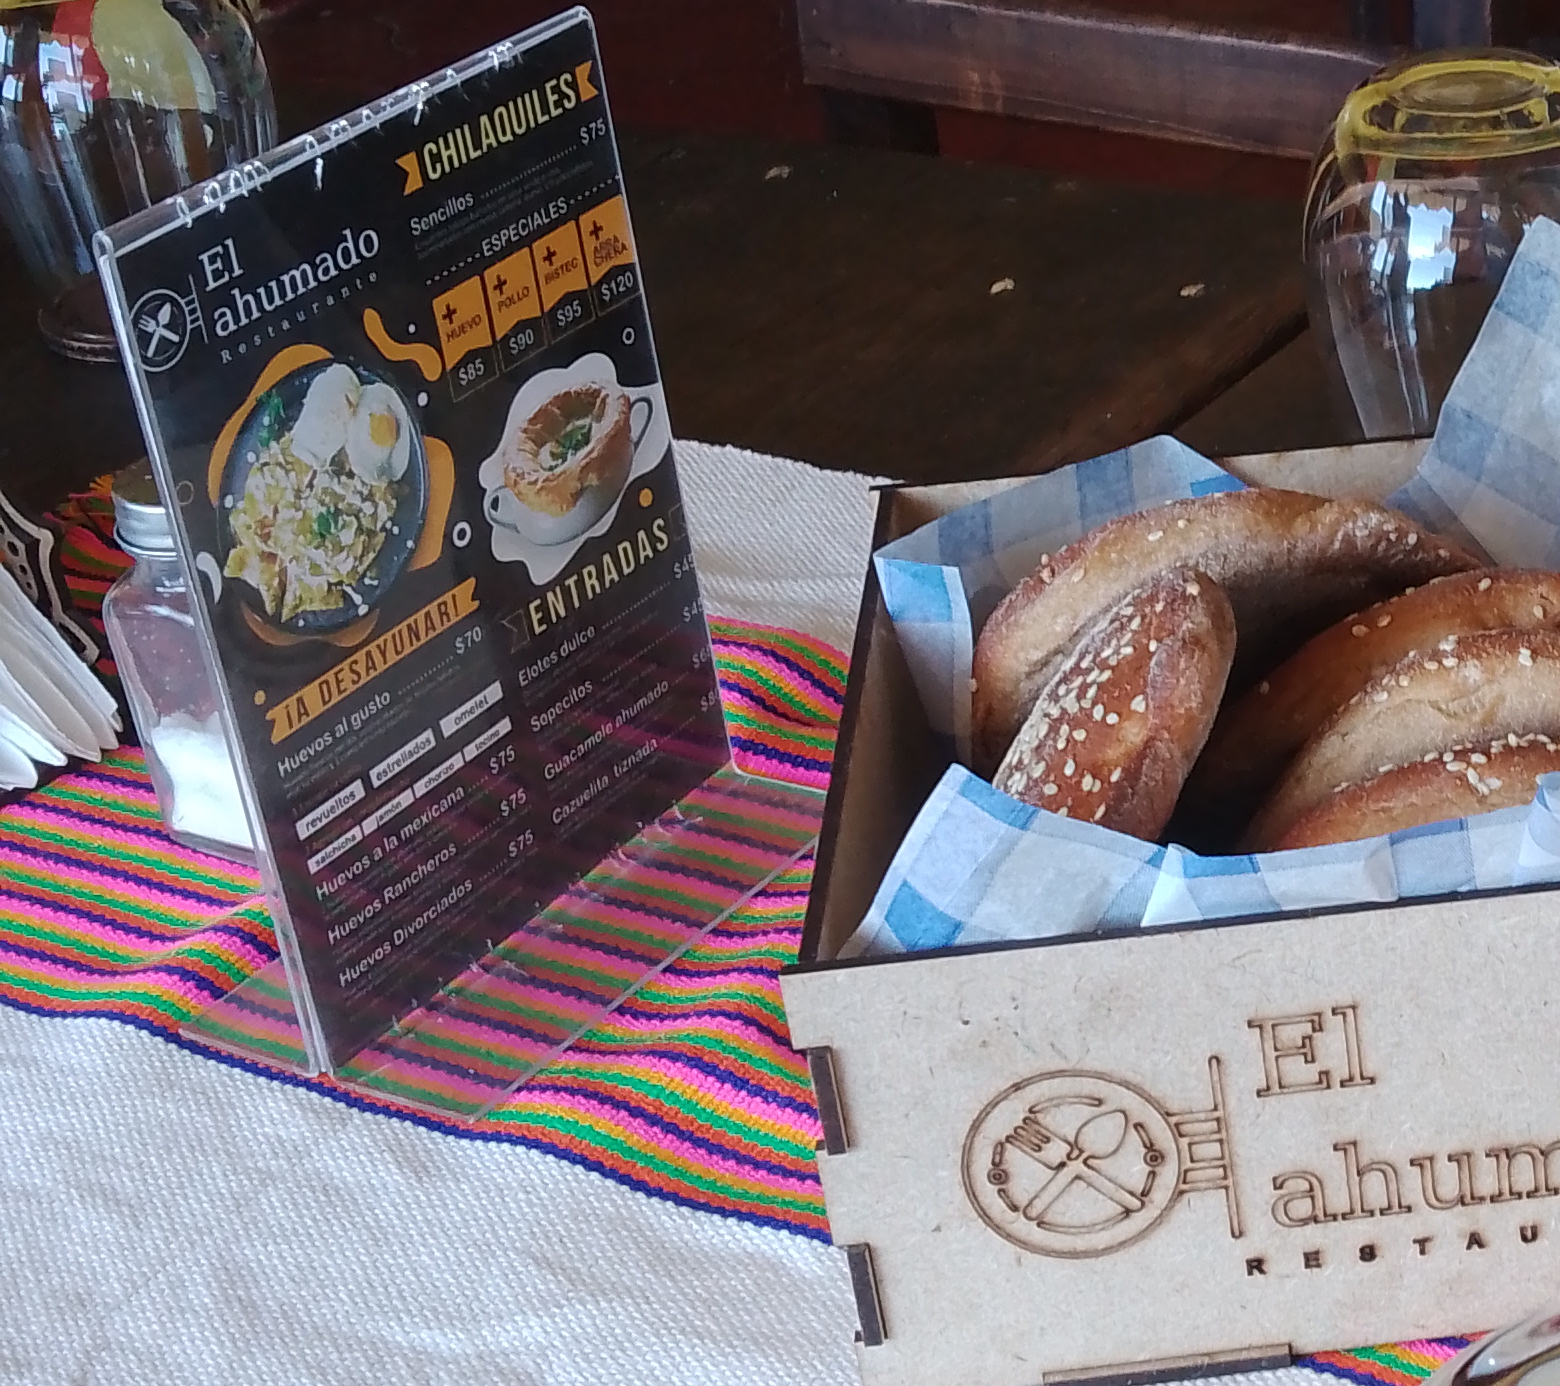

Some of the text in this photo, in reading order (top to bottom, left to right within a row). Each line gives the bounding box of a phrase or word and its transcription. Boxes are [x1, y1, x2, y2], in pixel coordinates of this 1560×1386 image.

[420, 70, 578, 182] CHILAQUILES
[409, 117, 607, 237] Sencillos $75
[198, 237, 244, 293] El
[480, 195, 568, 258] ESPECIALES
[212, 225, 380, 338] ahumado
[220, 271, 378, 363] Restaurante
[444, 312, 483, 343] HUEVO
[496, 284, 530, 313] POLLO
[555, 299, 582, 328] $95
[600, 269, 634, 303] $120
[456, 357, 485, 388] $85
[508, 327, 535, 357] $90
[527, 513, 670, 638] ENTRADAS
[517, 646, 559, 687] Elotes
[558, 619, 596, 659] dulce
[276, 623, 483, 779] Huevos al gusto $70
[529, 675, 593, 736] Sopecitos
[542, 718, 613, 782] Guacamole
[612, 676, 669, 729] ahumado
[303, 785, 356, 833] revueltos
[374, 731, 431, 781] estrellados
[452, 691, 489, 727] omelet
[550, 770, 610, 826] Cazuelita
[612, 733, 658, 780] tiznada
[313, 831, 356, 868] salchicha
[314, 849, 371, 903] Huevos
[371, 844, 383, 863] a
[382, 829, 399, 854] la
[398, 782, 465, 842] mexicana
[488, 743, 516, 776] $75
[326, 893, 382, 946] Huevos
[382, 839, 457, 905] Rancheros
[498, 785, 527, 819] $75
[337, 826, 534, 989] Huevos Divorciados $75
[1248, 1004, 1376, 1099] El
